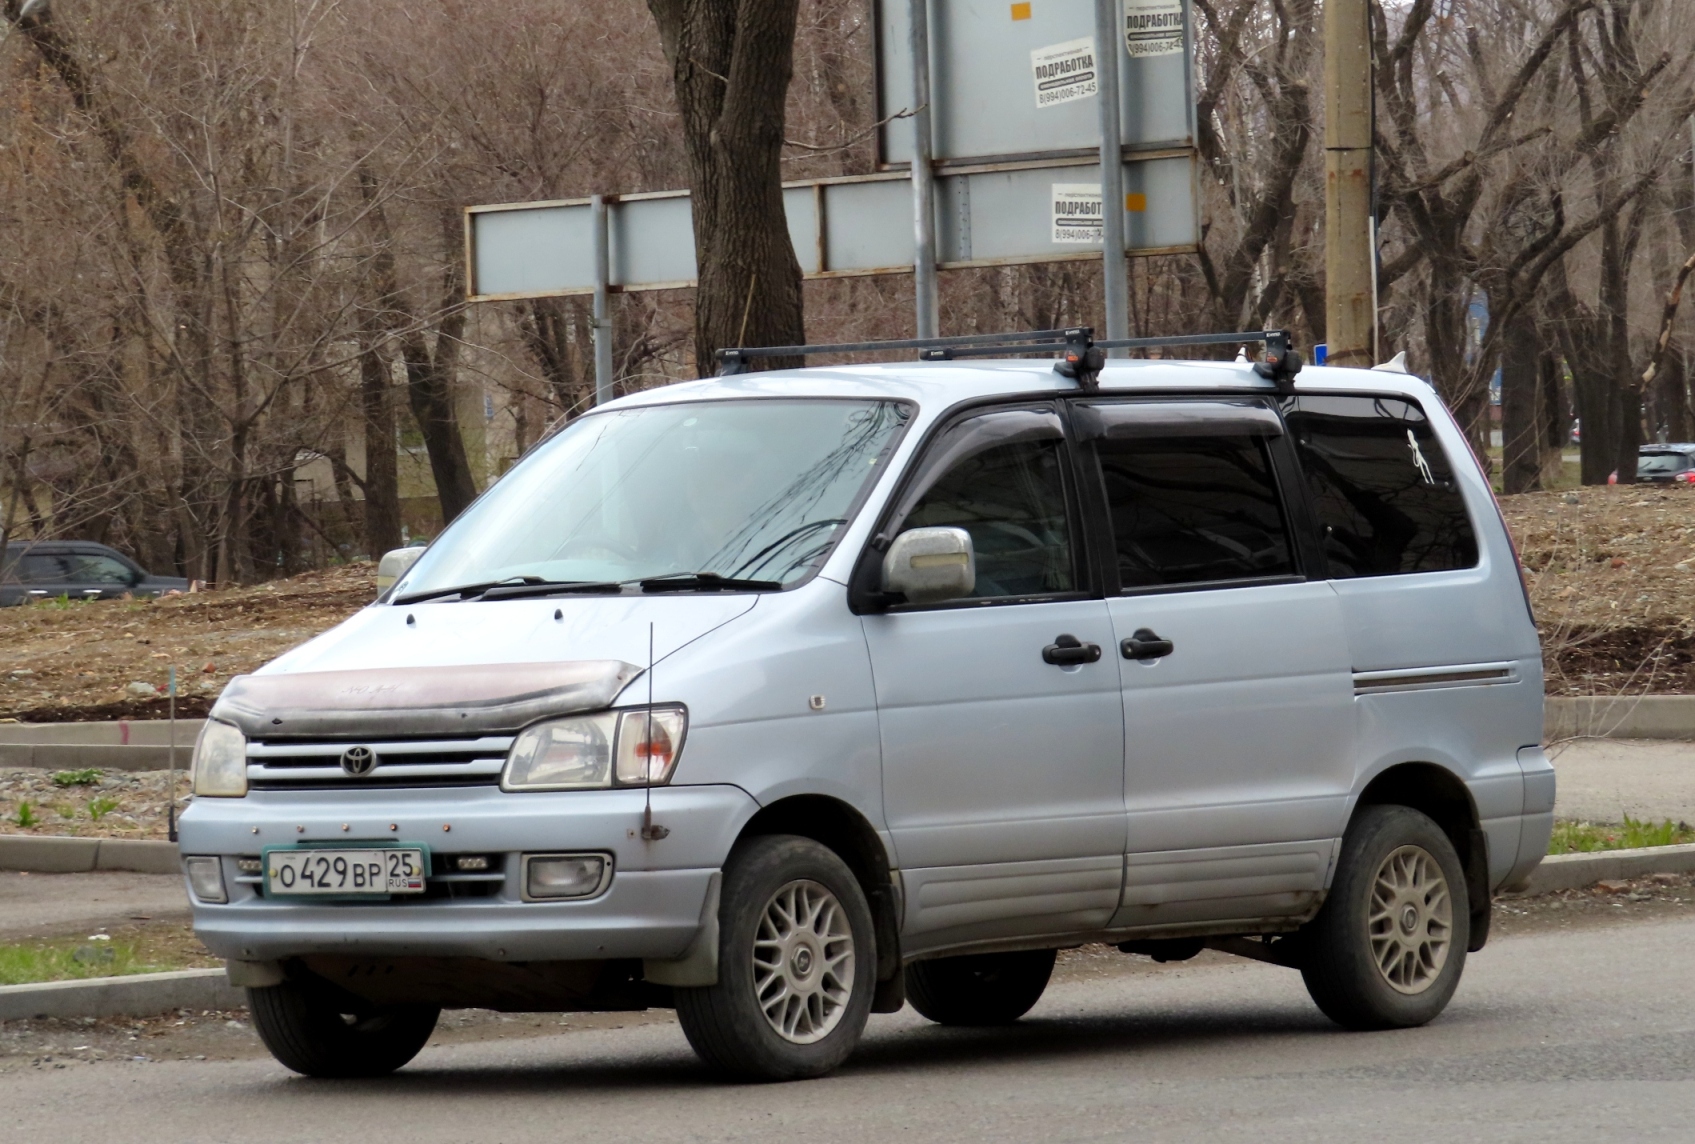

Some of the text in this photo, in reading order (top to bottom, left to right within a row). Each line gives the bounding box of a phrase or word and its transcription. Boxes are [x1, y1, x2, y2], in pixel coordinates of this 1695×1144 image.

[1035, 54, 1094, 80] ПОДРАБОТКА
[1039, 82, 1096, 105] 8(994)006-72-45
[1055, 201, 1102, 216] ПОДРАБОТ
[388, 853, 413, 878] 25
[388, 879, 408, 888] RUS
